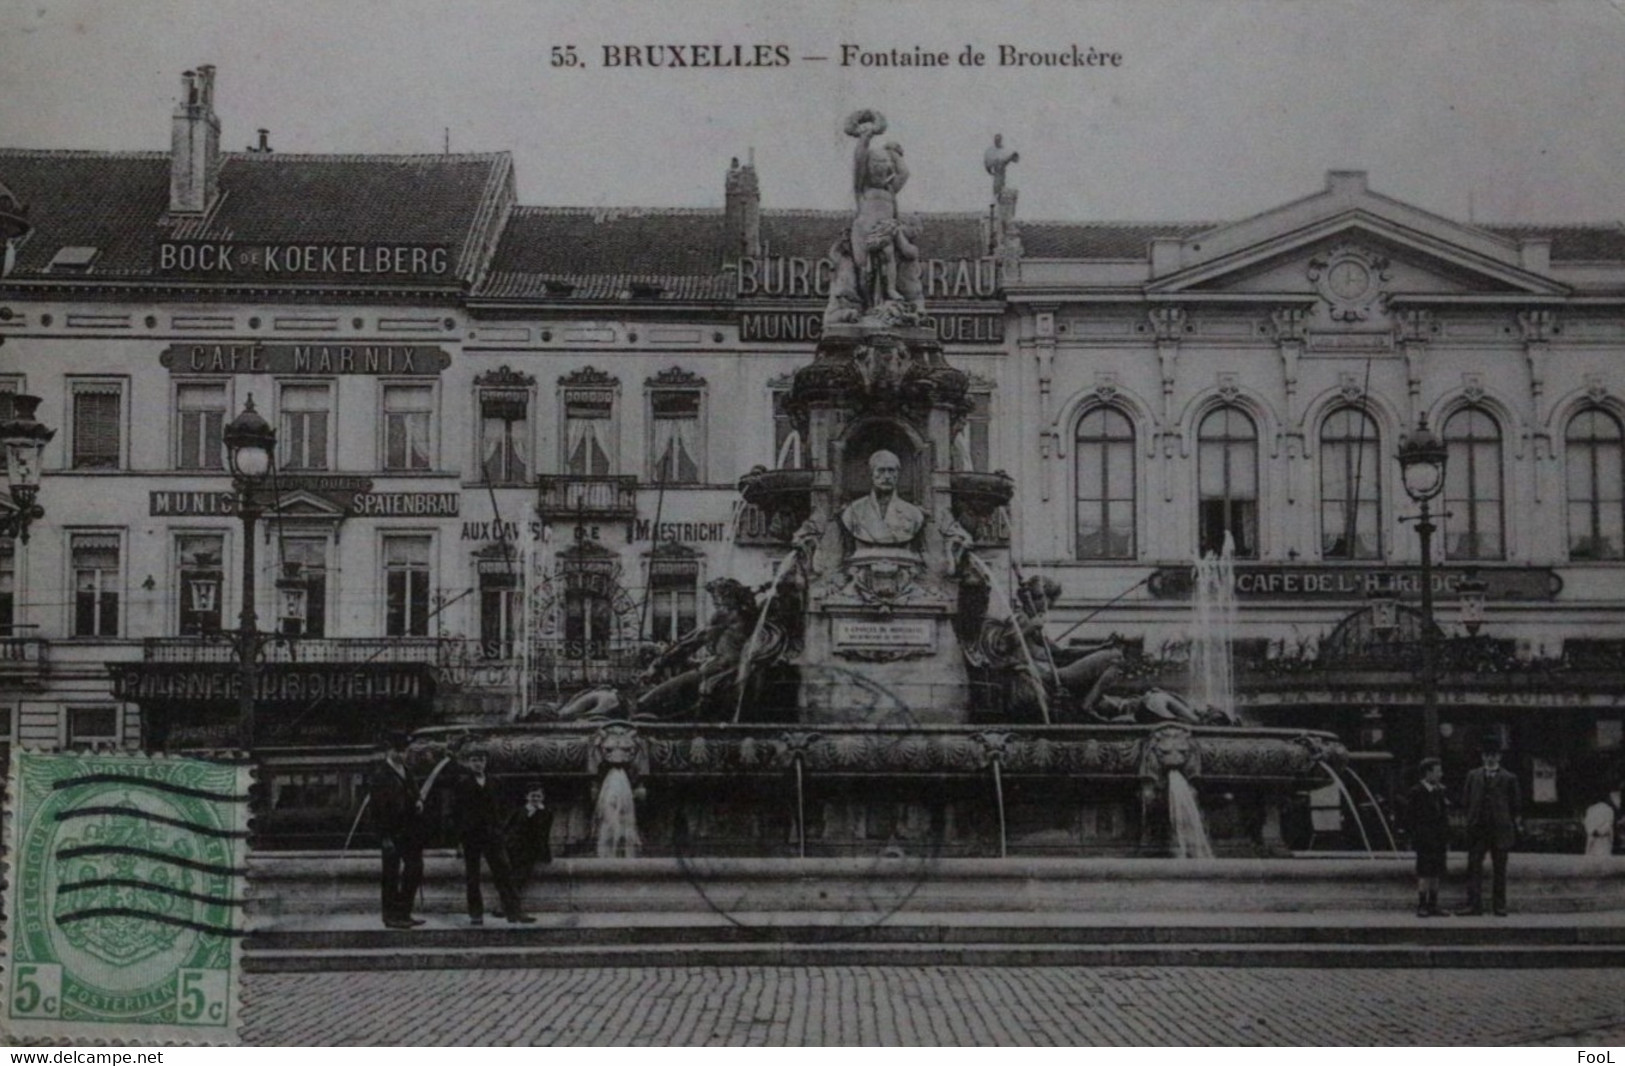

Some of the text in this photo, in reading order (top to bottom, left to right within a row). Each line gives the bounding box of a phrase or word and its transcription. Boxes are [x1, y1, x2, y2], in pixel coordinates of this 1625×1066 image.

[550, 46, 587, 69] 55.
[602, 45, 792, 68] BRUXELLES
[840, 45, 949, 68] Fontaine
[958, 46, 986, 68] de
[998, 44, 1123, 69] Brouckère
[161, 243, 448, 274] BOCK DE KOEKELBERG
[743, 314, 1001, 341] MUNIC UELL
[294, 345, 416, 373] MARNIX
[156, 493, 244, 513] MUNIC
[353, 493, 459, 514] SPATENBRAU
[461, 521, 489, 541] AUX
[492, 518, 538, 541] CAVS
[1303, 573, 1334, 592] DE
[91, 763, 166, 782] POSTES
[25, 823, 50, 933] BELGIQUE
